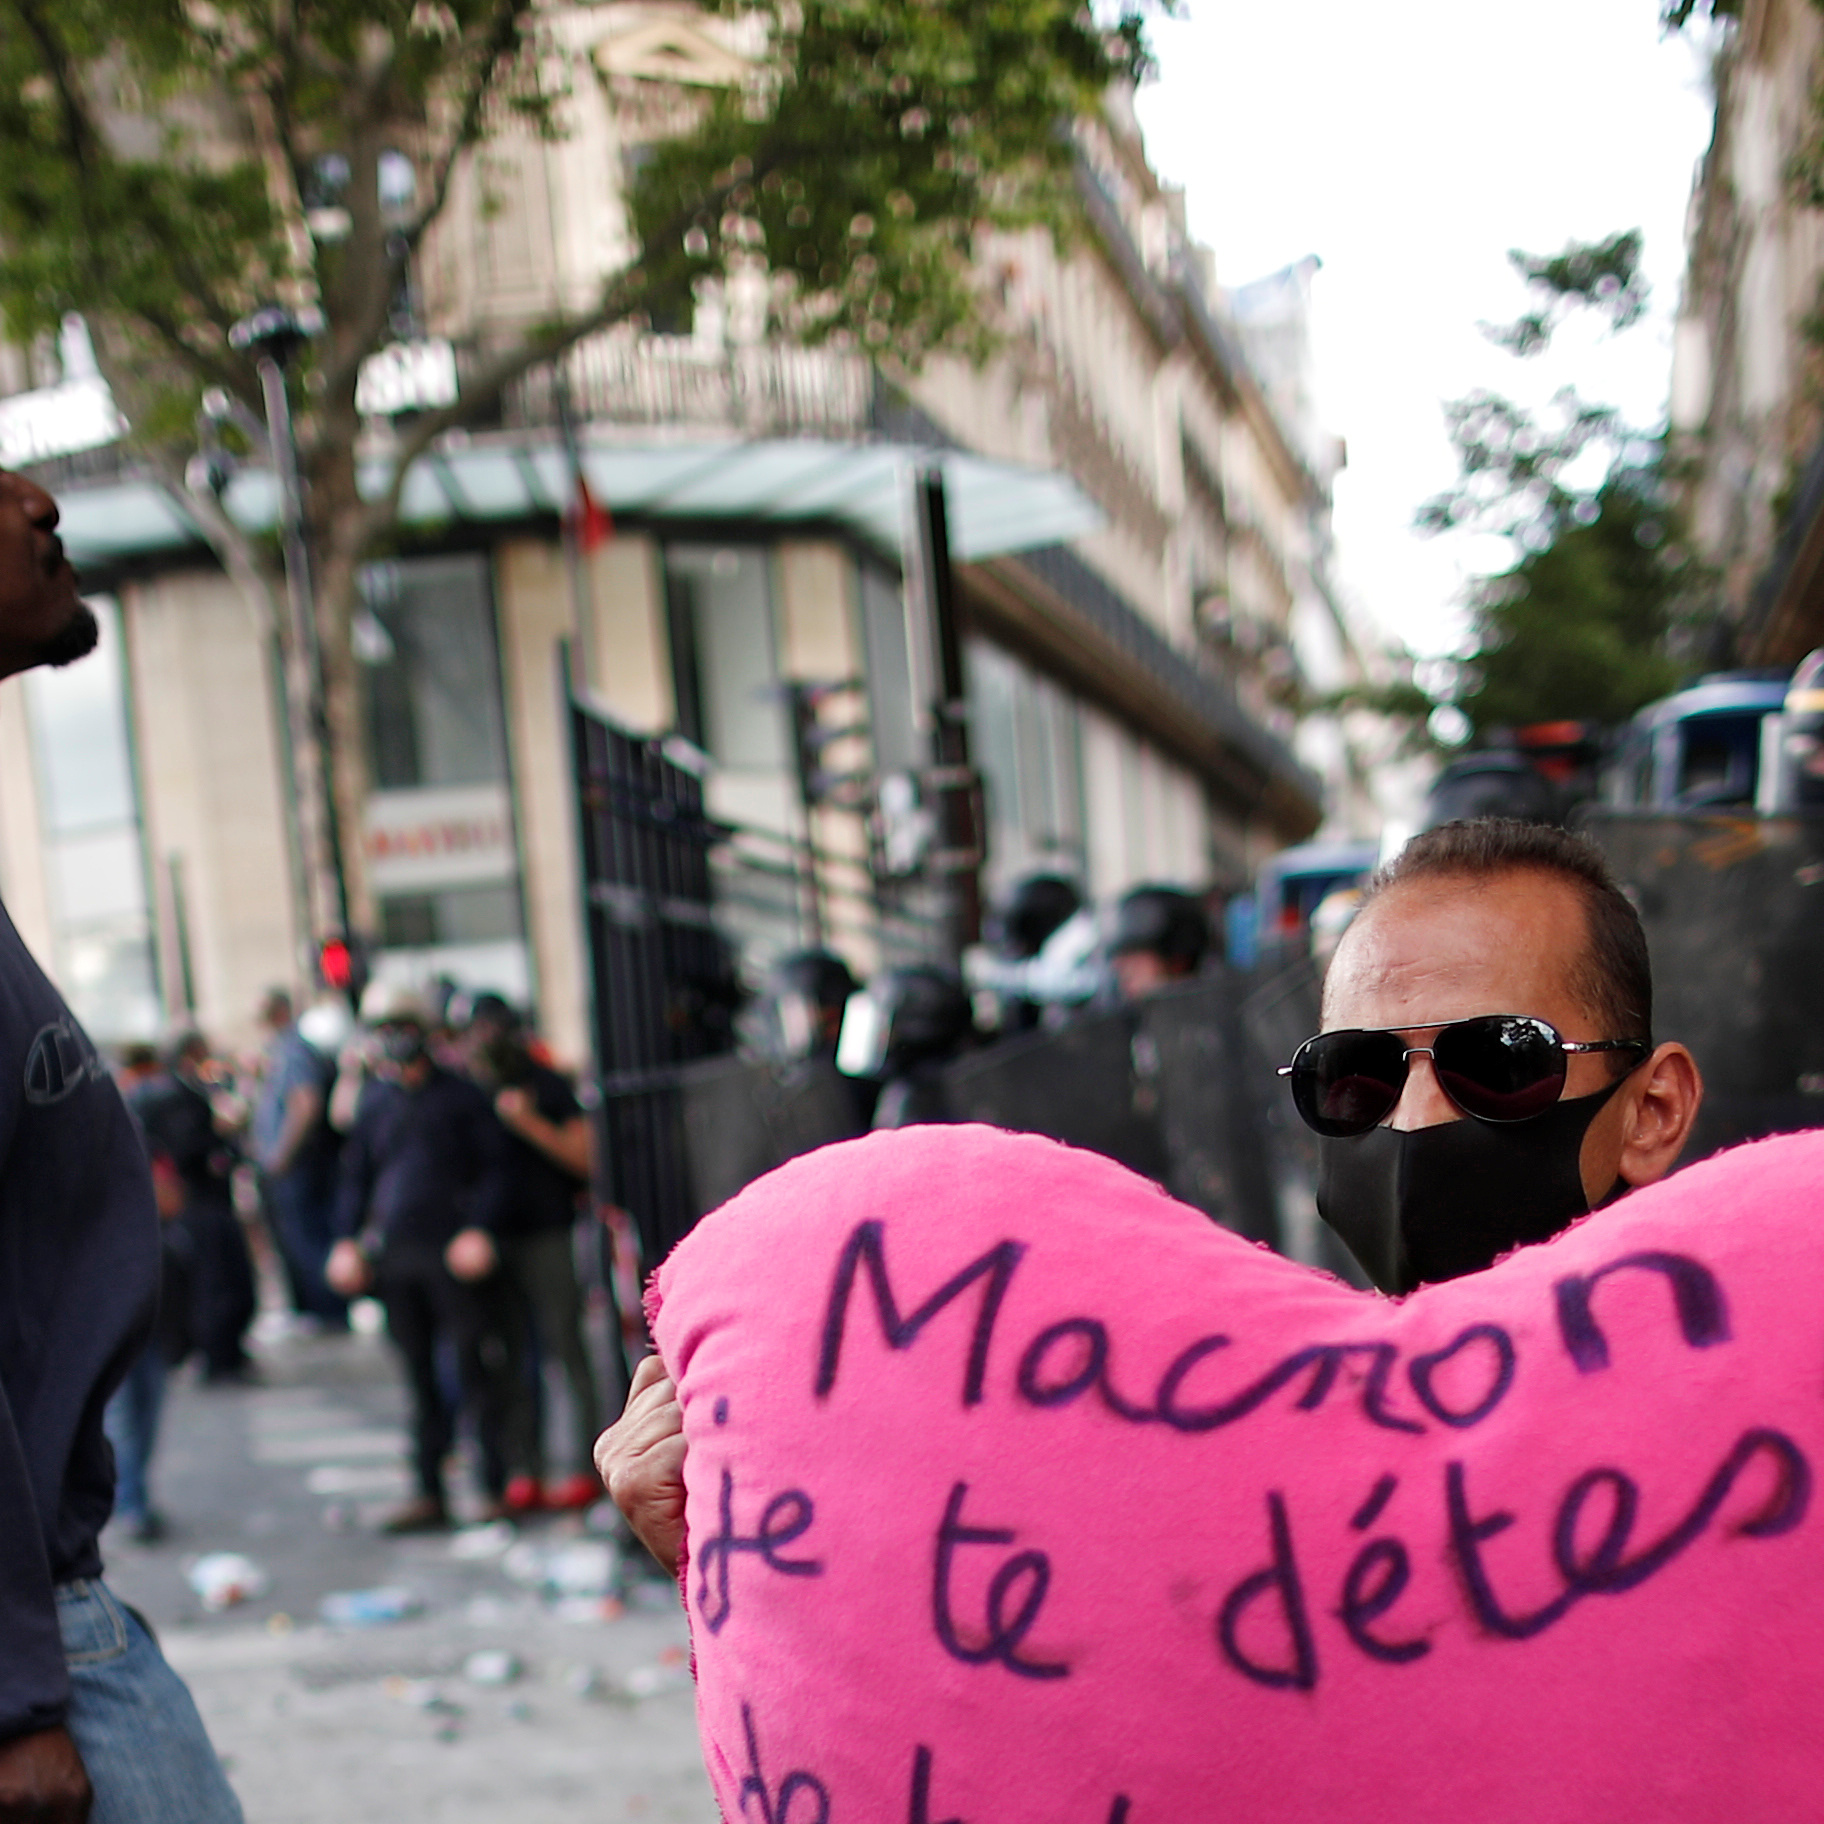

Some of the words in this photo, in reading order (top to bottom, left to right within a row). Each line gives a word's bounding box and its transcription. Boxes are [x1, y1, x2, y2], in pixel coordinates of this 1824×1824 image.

[814, 1218, 1732, 1434] Macron
[698, 1392, 831, 1632] je
[933, 1482, 1072, 1680] te
